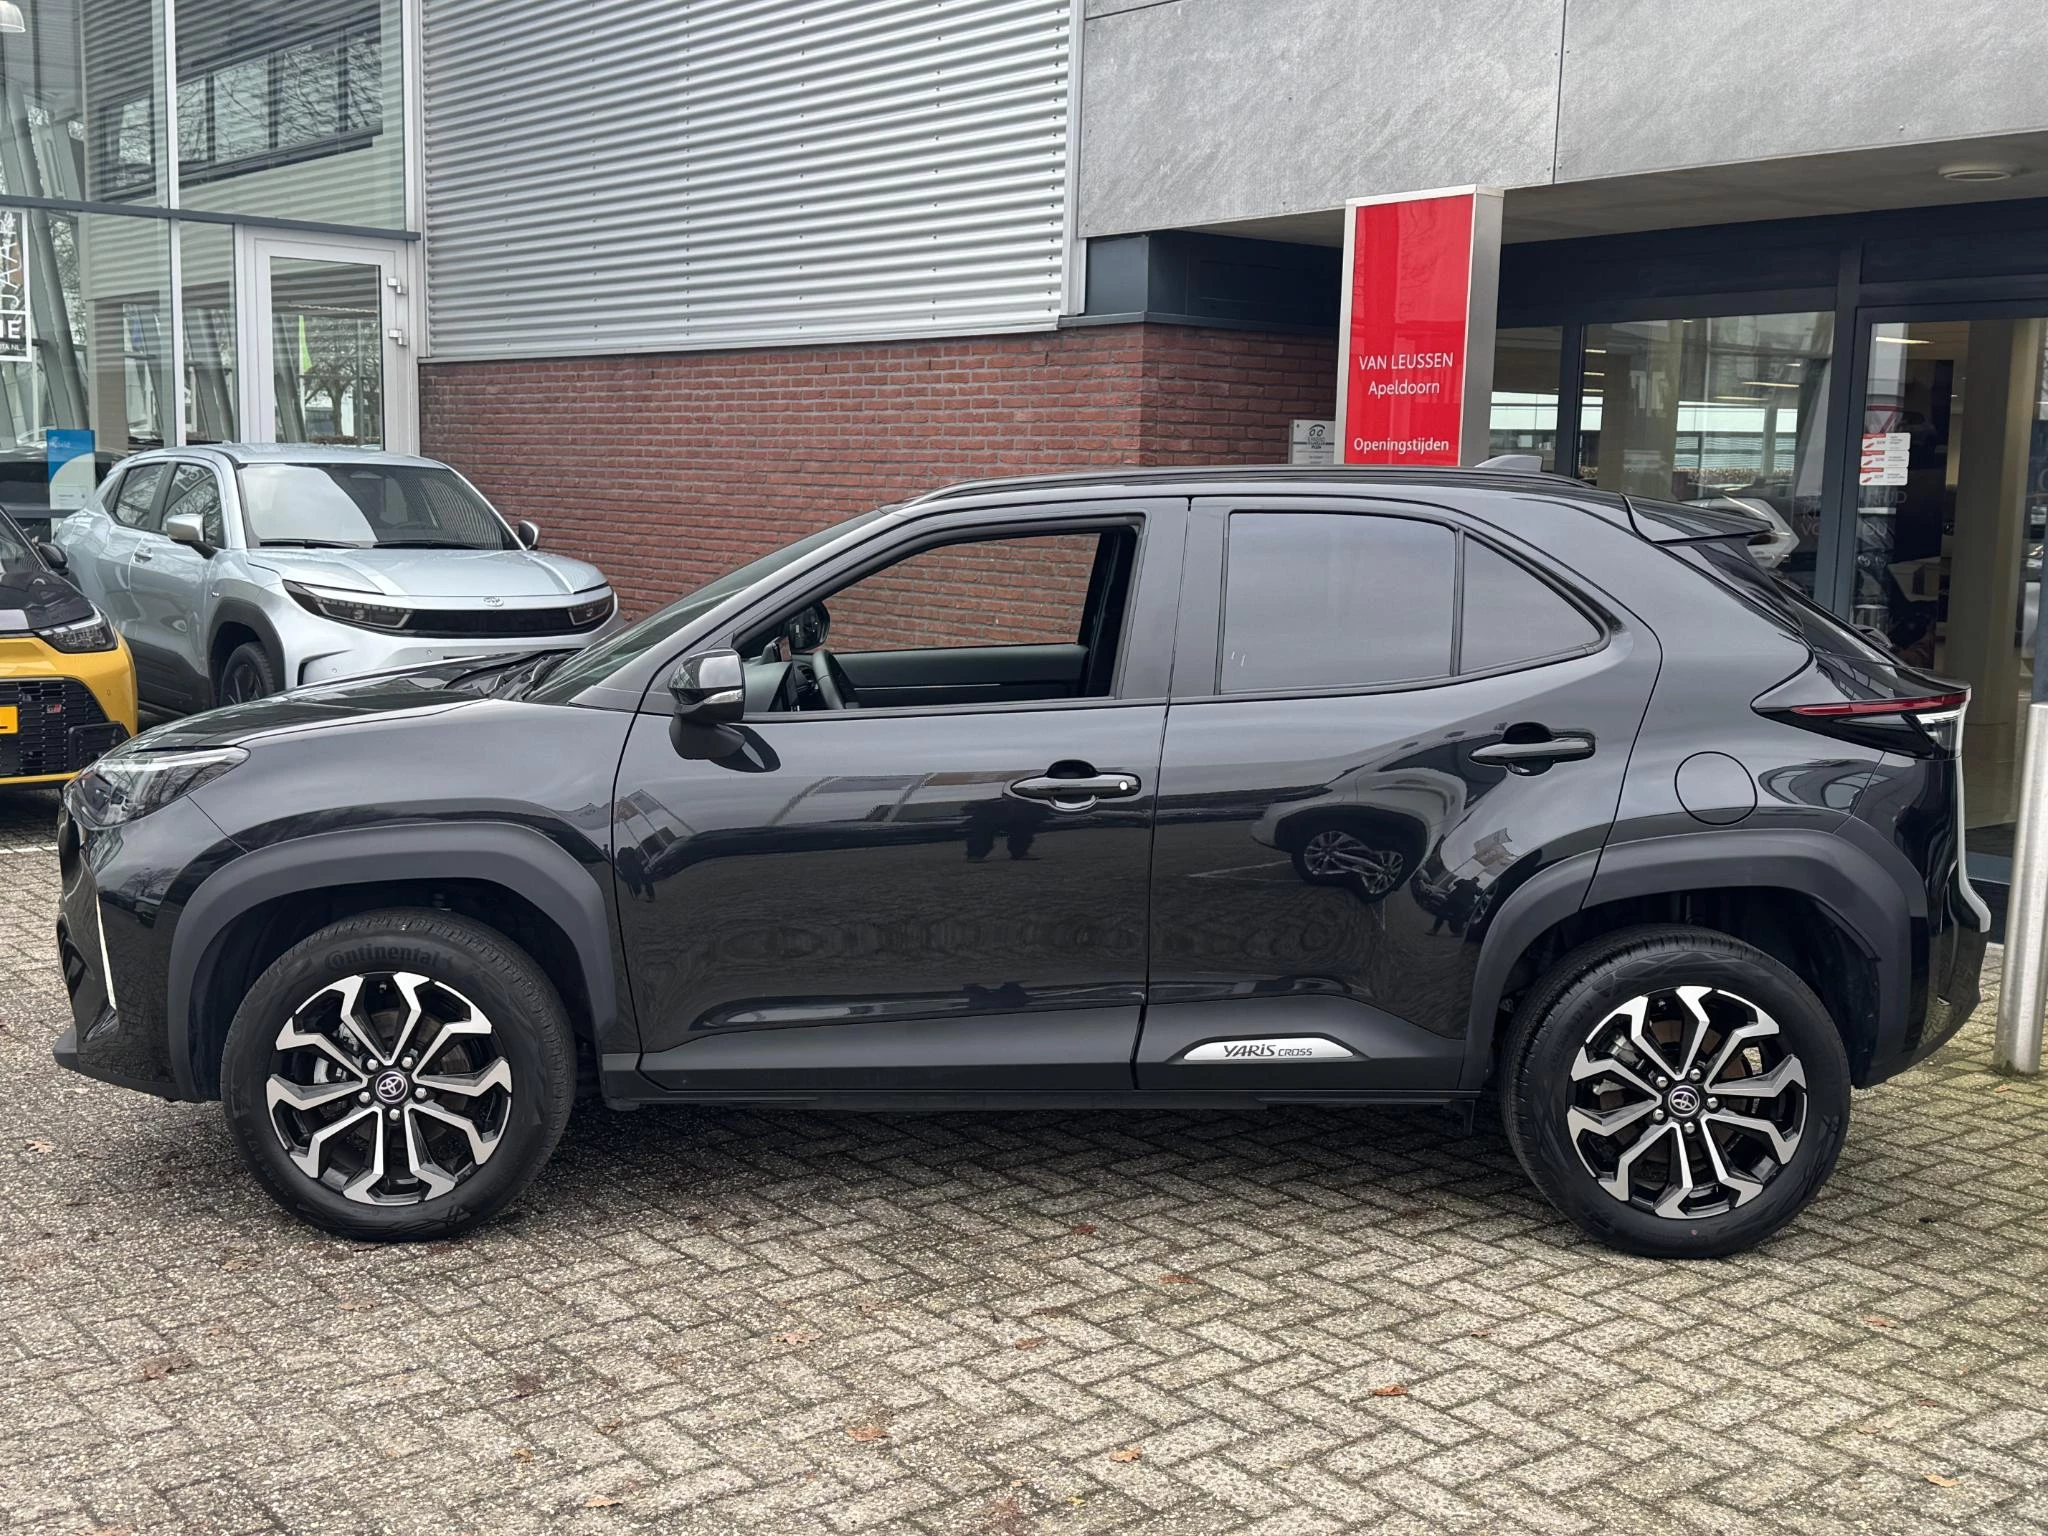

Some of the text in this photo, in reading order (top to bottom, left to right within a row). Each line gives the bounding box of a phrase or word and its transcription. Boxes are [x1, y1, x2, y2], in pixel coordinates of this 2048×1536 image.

[1359, 352, 1454, 370] VAN LEUSSEN
[1367, 379, 1440, 399] Apeldoorn
[1353, 437, 1449, 454] Openingstijden
[1278, 1047, 1313, 1057] CROSS
